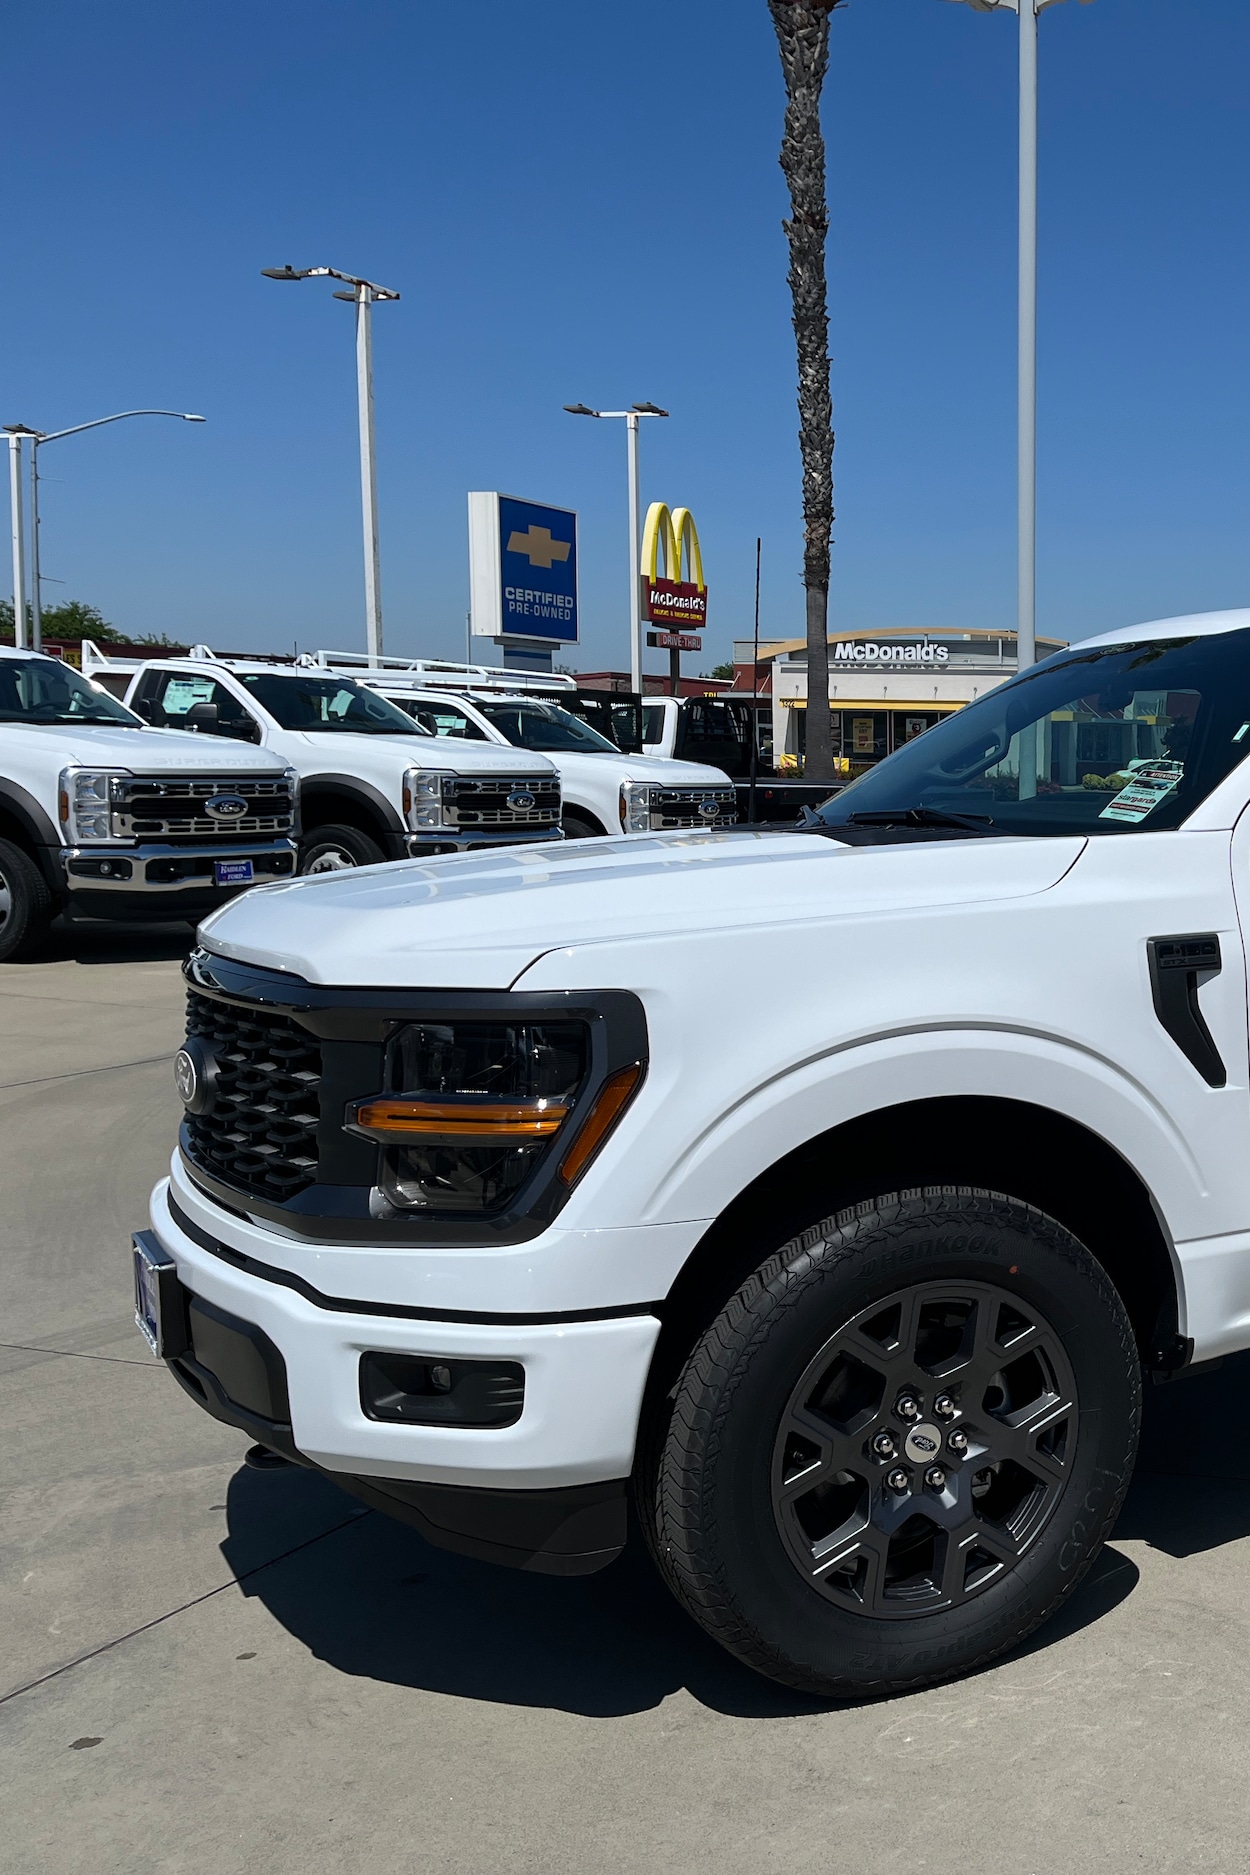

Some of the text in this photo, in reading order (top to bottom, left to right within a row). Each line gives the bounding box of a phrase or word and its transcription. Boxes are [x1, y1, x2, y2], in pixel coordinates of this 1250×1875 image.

[505, 586, 574, 608] CERTIFIED
[650, 590, 705, 611] McDonald's
[508, 600, 571, 621] PRE-OWNED
[662, 635, 701, 649] DRIVE-THRU
[834, 642, 949, 661] McDonald's
